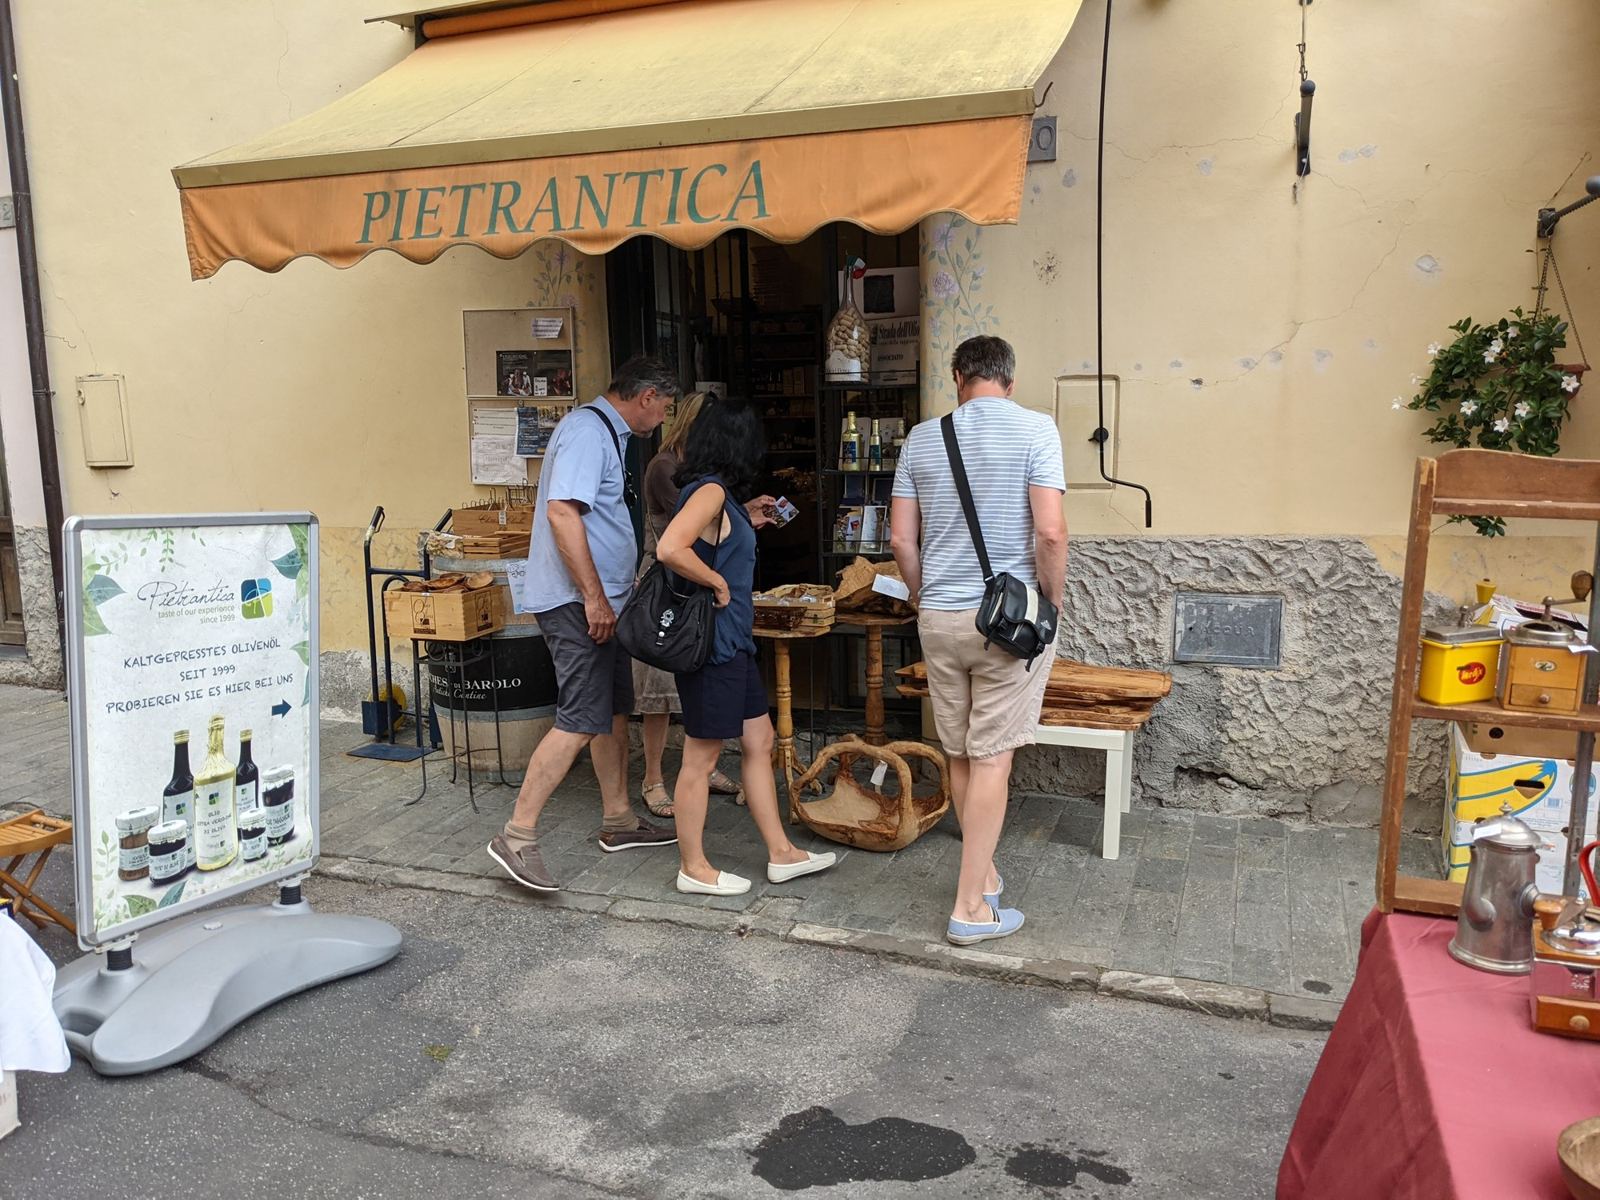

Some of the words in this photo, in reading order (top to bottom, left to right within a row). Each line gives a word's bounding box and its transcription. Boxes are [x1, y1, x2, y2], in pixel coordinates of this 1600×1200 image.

[355, 159, 771, 243] PIETRANTICA
[137, 579, 234, 610] Pietrantica
[158, 610, 175, 618] taste
[176, 608, 183, 617] of
[184, 608, 197, 616] our
[198, 604, 235, 617] experience
[200, 616, 218, 624] since
[219, 614, 235, 623] 1999
[124, 646, 227, 669] KALTGEPRESSTES
[231, 637, 281, 654] OLIVENÖL
[179, 668, 206, 682] SEIT
[212, 665, 236, 676] 1999
[463, 677, 522, 690] BAROLO
[106, 693, 180, 714] PROBIEREN
[185, 689, 203, 701] SIE
[208, 686, 221, 697] ES
[225, 682, 251, 694] HIER
[255, 678, 272, 689] BEI
[277, 673, 293, 685] UNS
